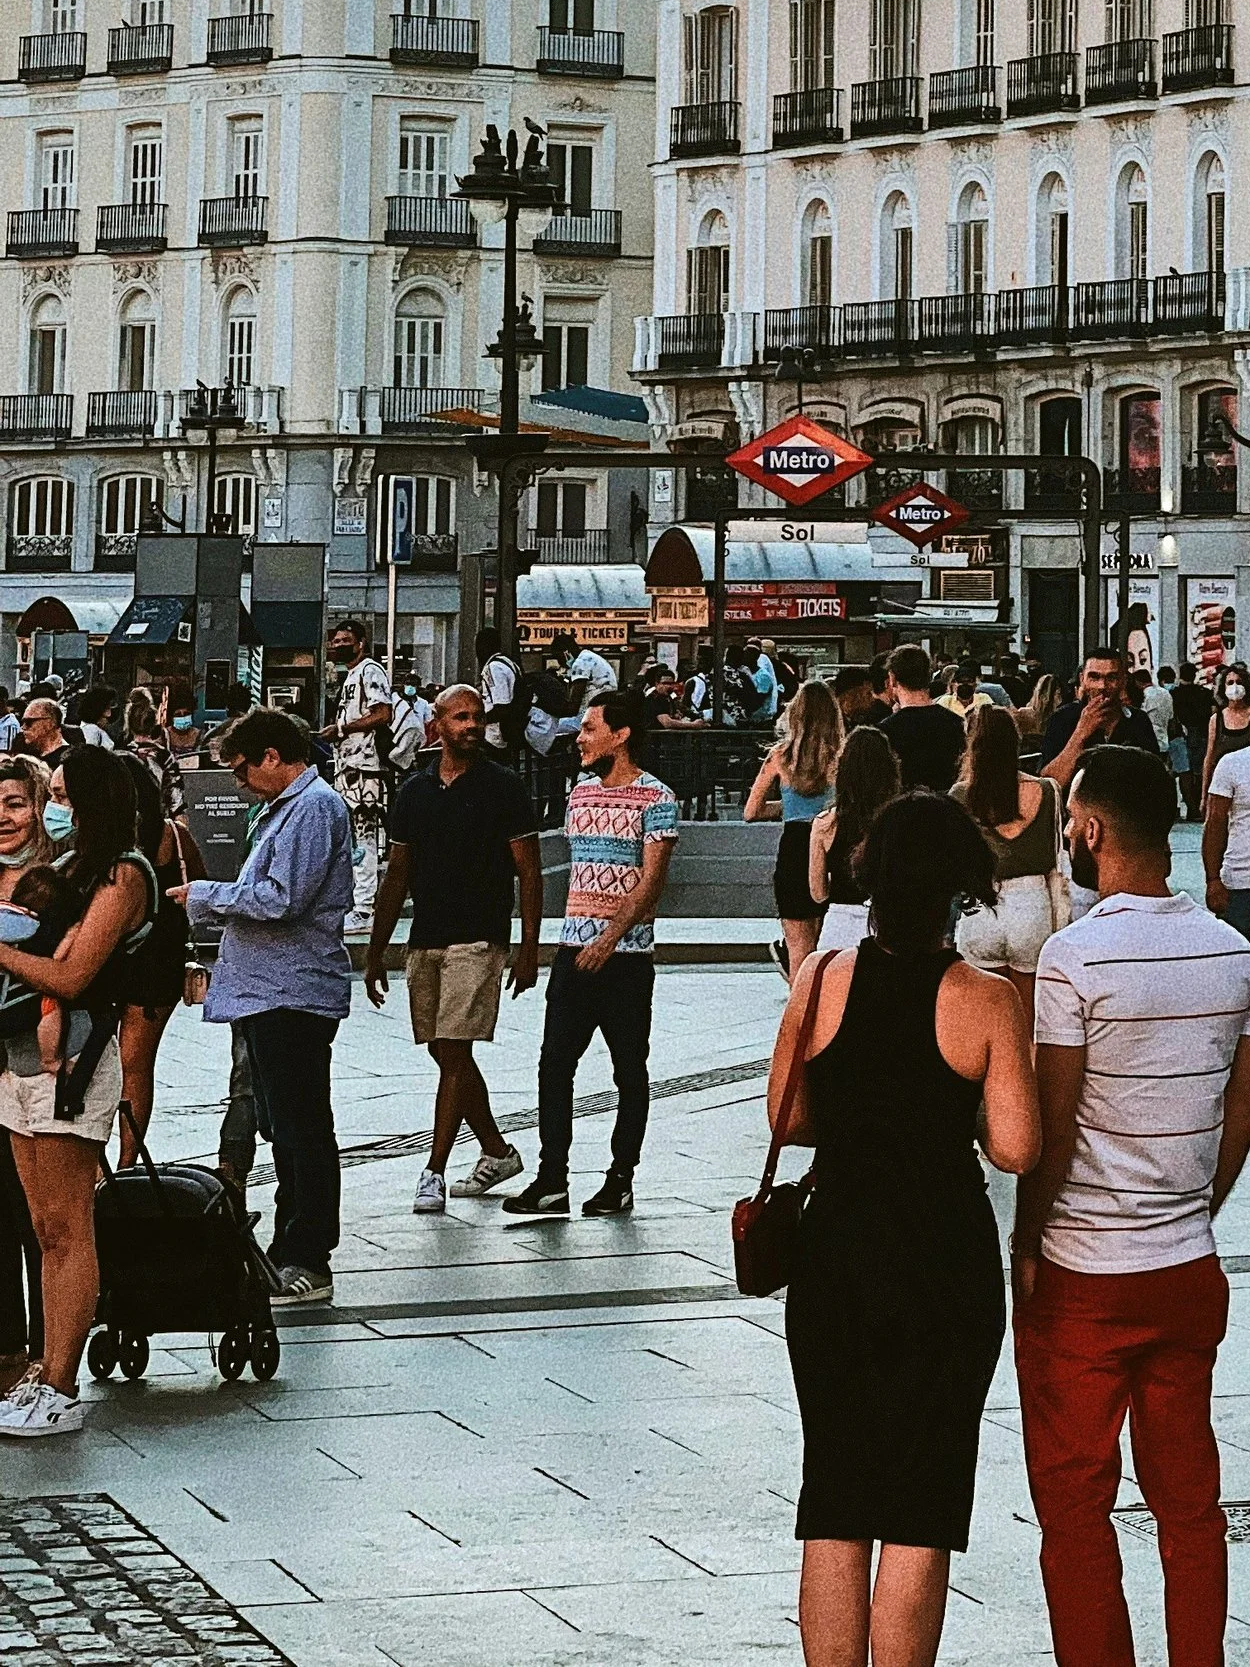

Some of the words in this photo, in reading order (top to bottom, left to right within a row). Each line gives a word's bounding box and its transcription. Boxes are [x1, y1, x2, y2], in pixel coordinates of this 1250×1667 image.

[768, 450, 831, 470] Metro
[898, 506, 942, 521] Metro
[780, 523, 816, 542] Sol
[910, 555, 931, 565] Sol
[795, 598, 842, 618] TICKETS
[581, 627, 625, 639] TICKETS
